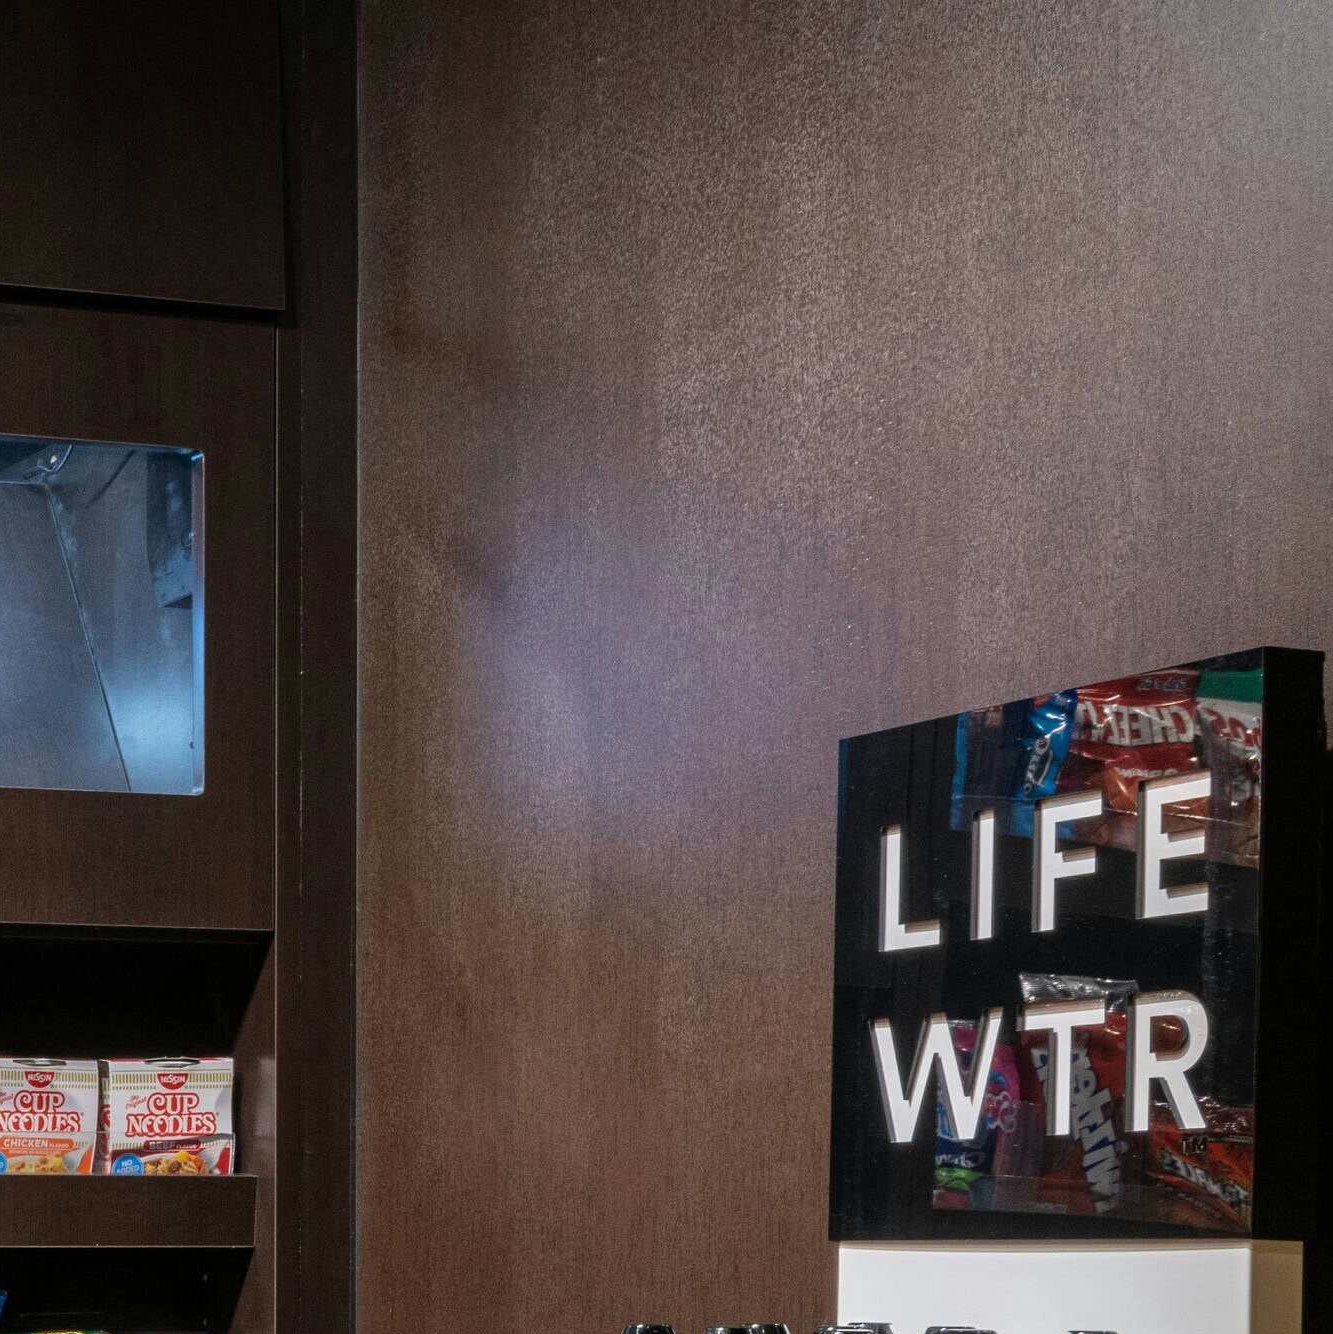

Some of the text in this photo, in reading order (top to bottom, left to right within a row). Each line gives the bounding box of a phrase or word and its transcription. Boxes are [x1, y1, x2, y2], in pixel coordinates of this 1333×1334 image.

[878, 770, 1211, 952] LIFE
[28, 1073, 53, 1083] NISSIN
[161, 1074, 186, 1084] NISSIN
[870, 992, 1211, 1144] WTR
[14, 1091, 65, 1114] CUP
[147, 1093, 199, 1116] CUP
[126, 1114, 218, 1137] NOODLES
[4, 1139, 49, 1148] CHICKEN
